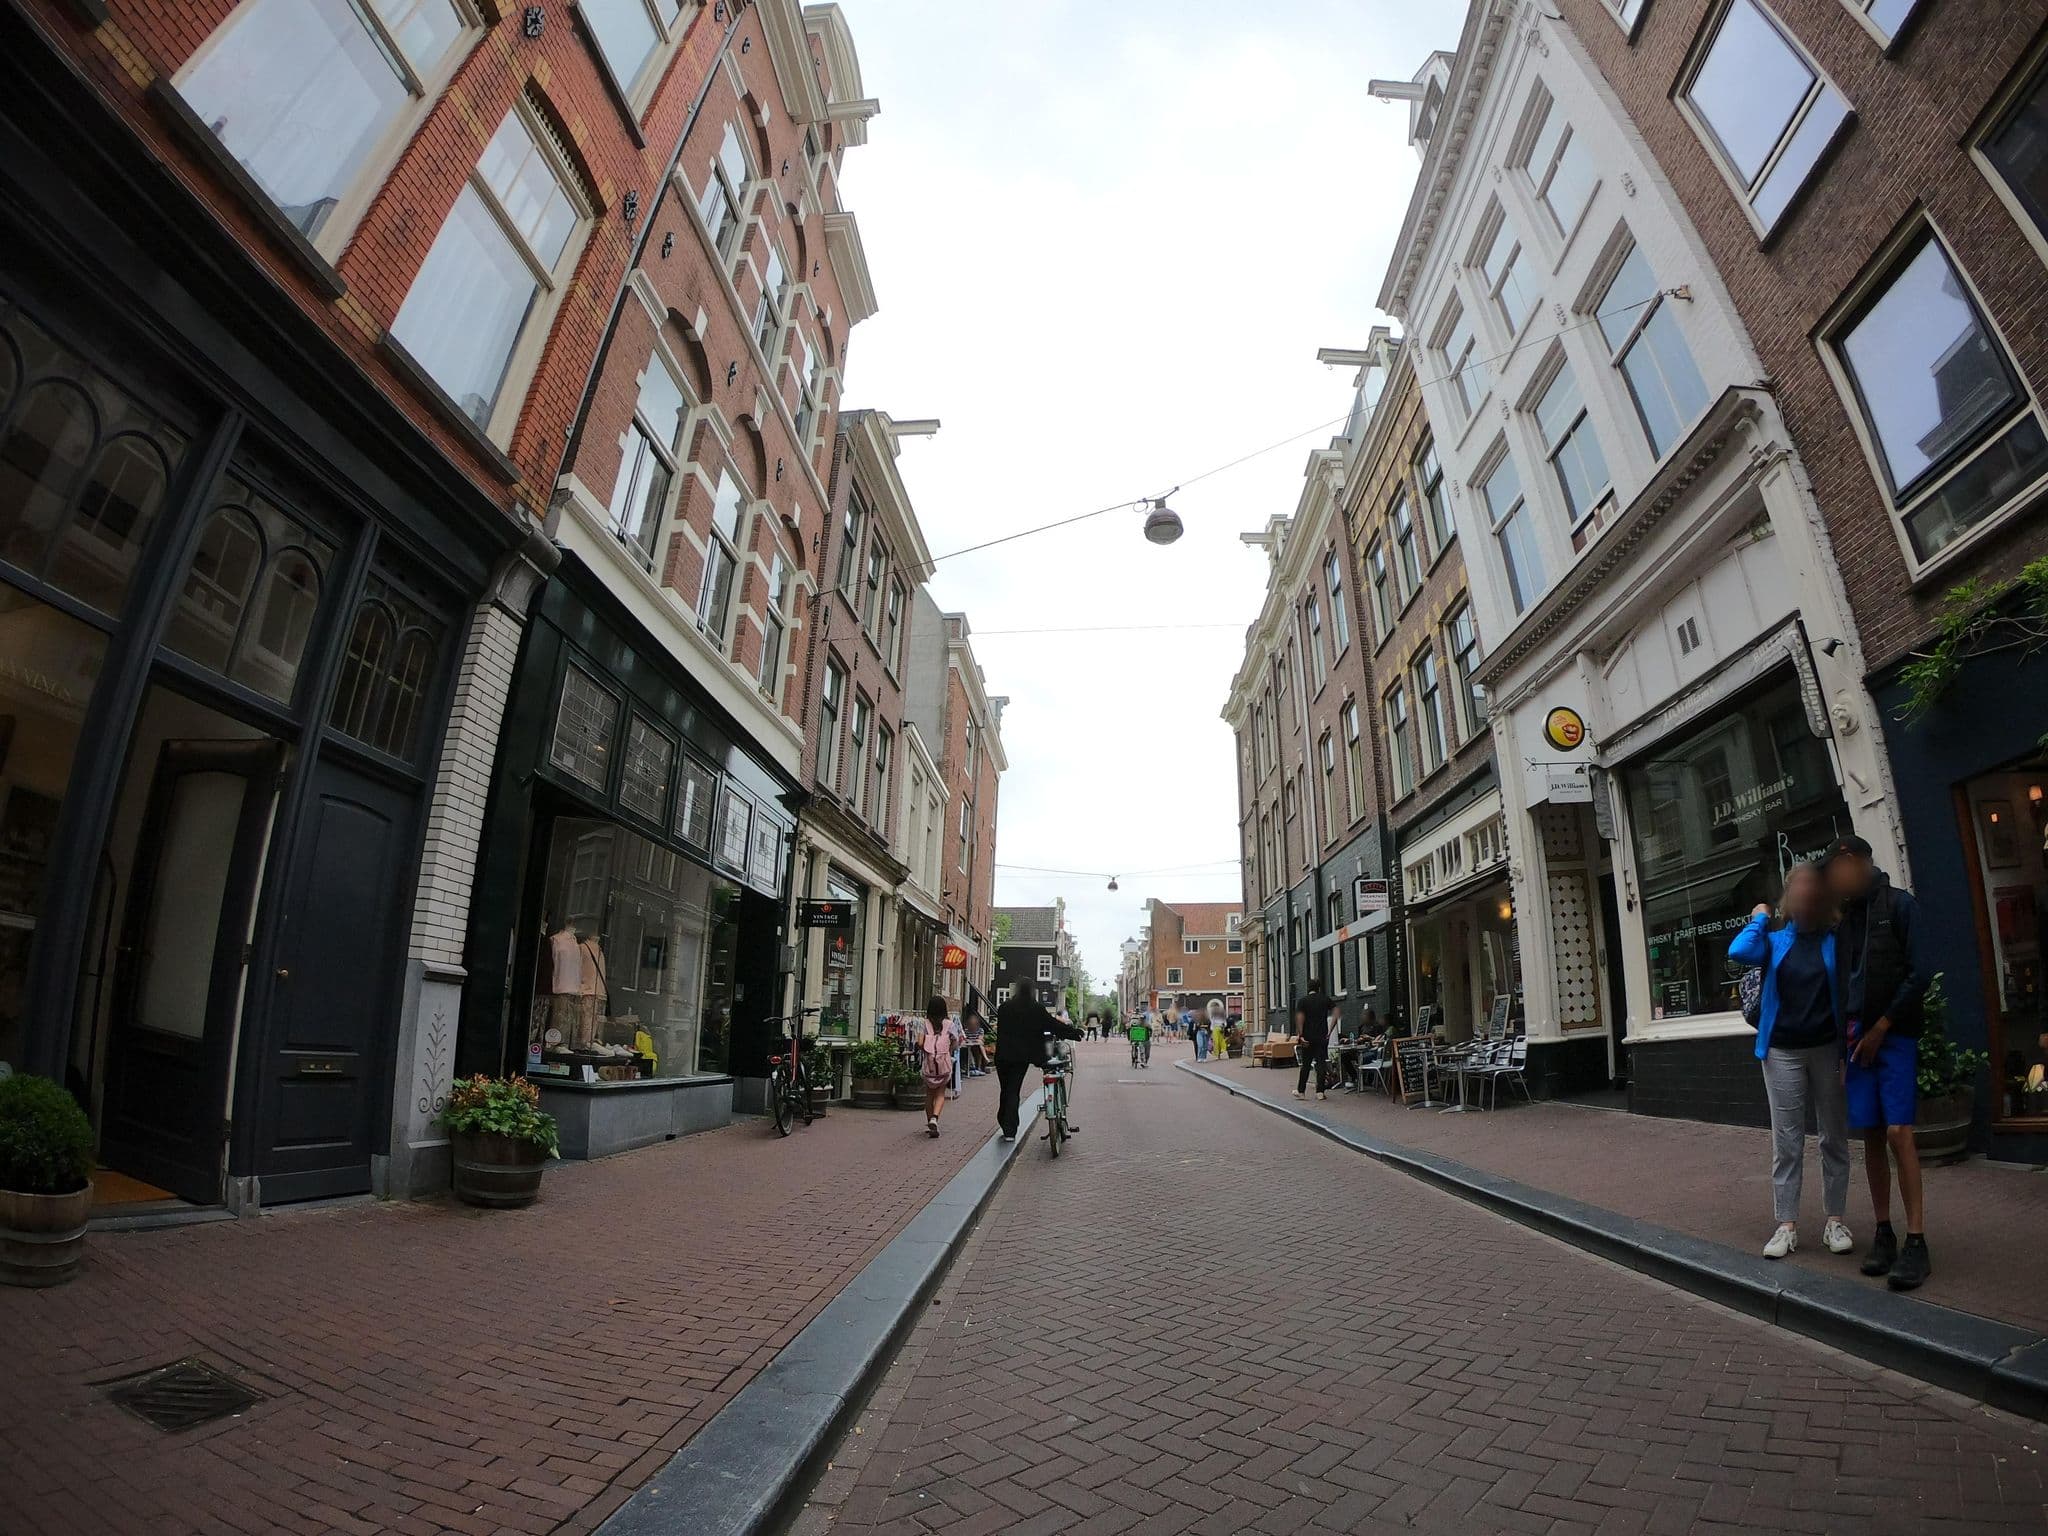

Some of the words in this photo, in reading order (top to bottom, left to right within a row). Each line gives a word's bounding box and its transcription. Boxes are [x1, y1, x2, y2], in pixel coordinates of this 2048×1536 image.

[1732, 807, 1762, 825] WHISKY
[1765, 798, 1783, 812] BAR
[1647, 932, 1671, 946] WHISKY
[1674, 926, 1697, 940] CRAFT
[1698, 920, 1722, 935] BEERS
[1724, 914, 1753, 930] COCKT
[945, 949, 965, 965] illy
